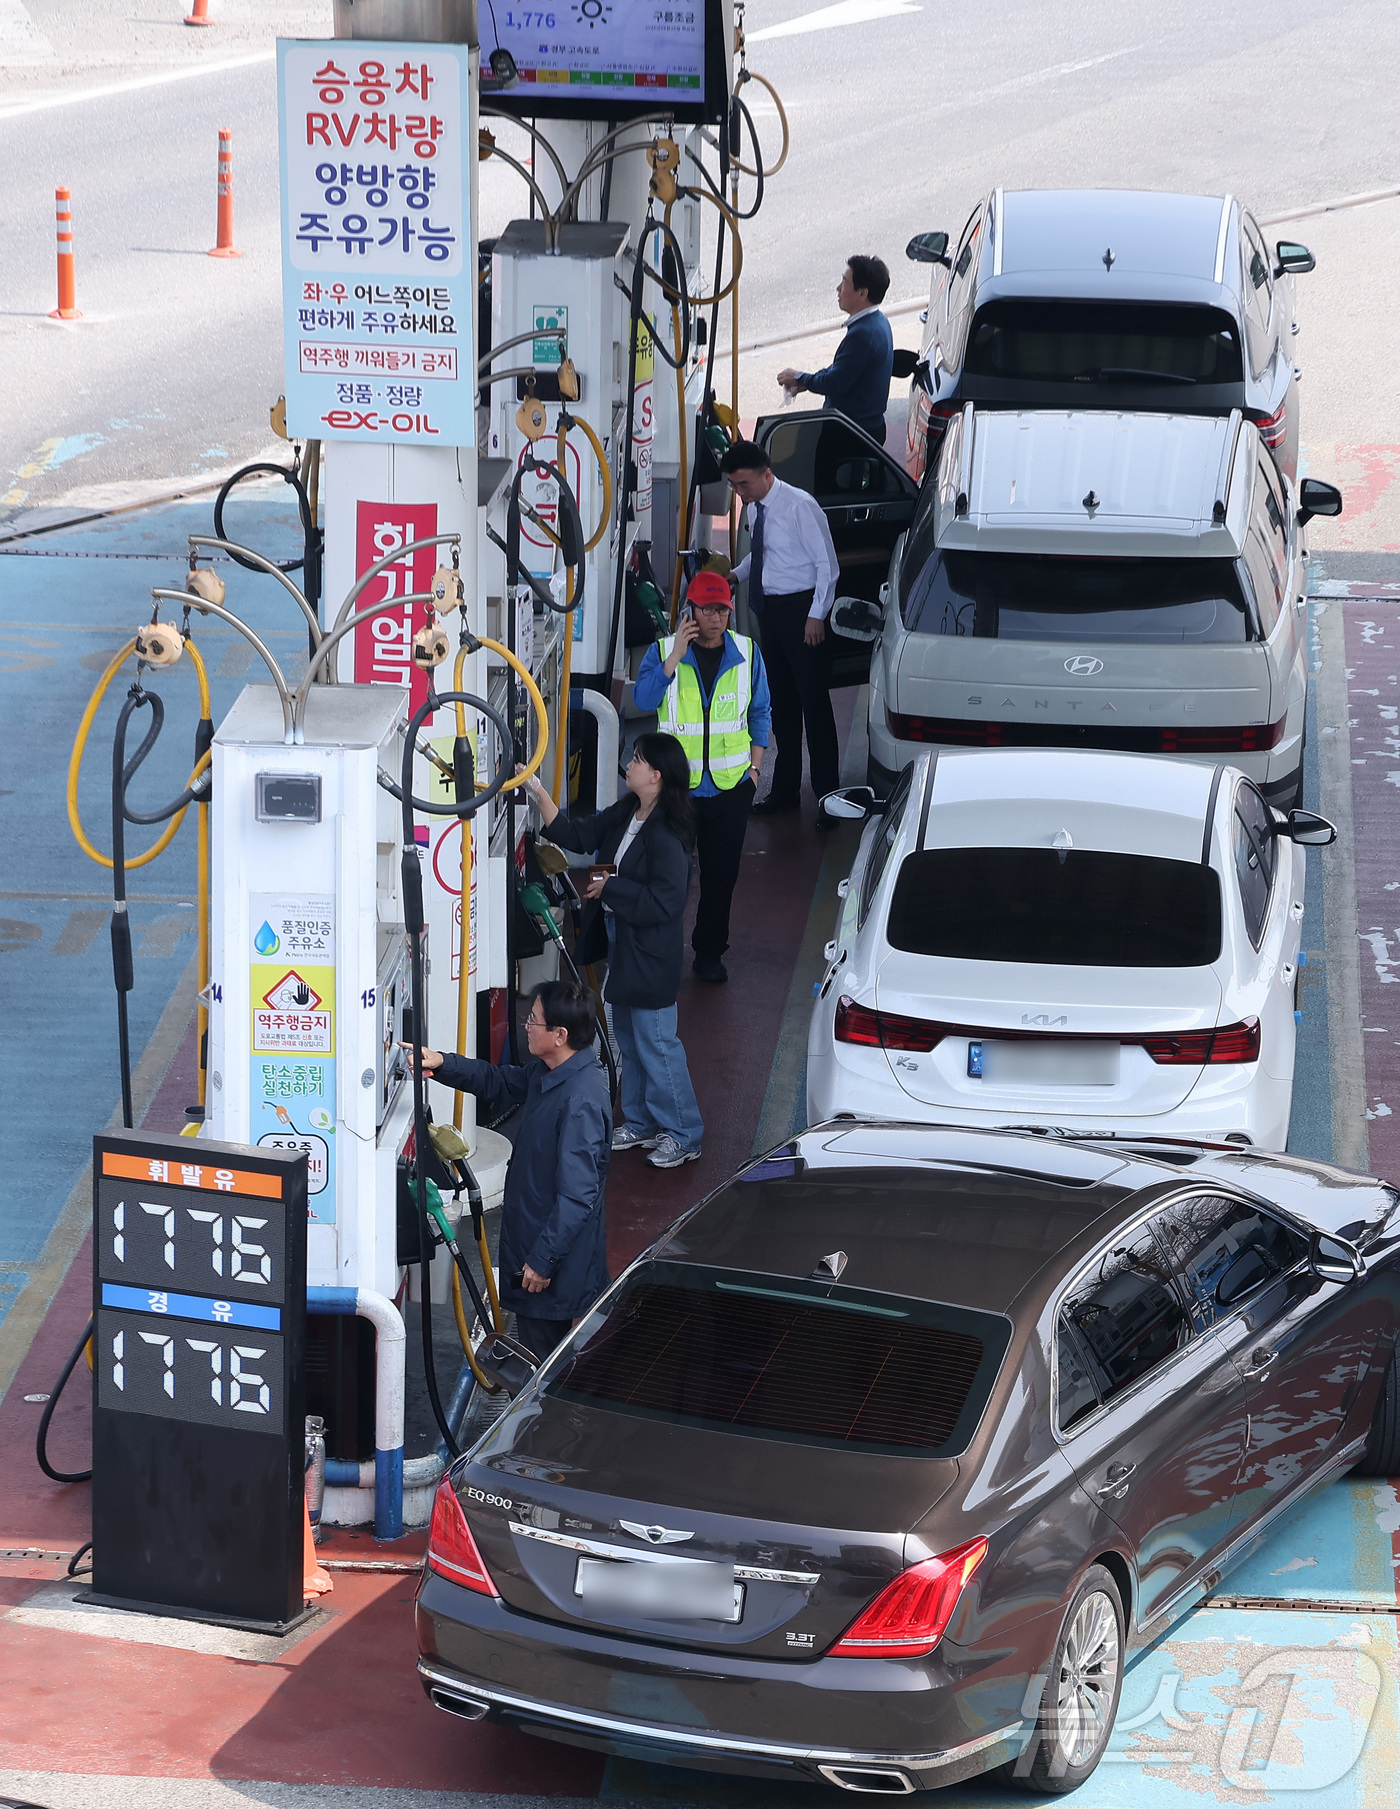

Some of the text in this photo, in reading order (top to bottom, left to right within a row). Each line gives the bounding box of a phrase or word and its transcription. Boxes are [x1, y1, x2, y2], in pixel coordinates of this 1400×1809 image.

[506, 11, 556, 31] 1,776
[312, 60, 434, 106] 승용차
[306, 112, 444, 159] RV차량
[315, 163, 436, 210] 양방향
[296, 213, 456, 261] 주유가능
[303, 282, 451, 311] 좌·우 어느쪽이든
[298, 308, 458, 335] 편하게 주유하세요
[303, 347, 452, 372] 역주행 끼워들기 금지
[492, 434, 498, 449] 6
[602, 437, 610, 452] 7
[967, 696, 1118, 713] SANTA
[281, 920, 332, 936] 품질인증
[287, 936, 326, 950] 주유소
[211, 982, 223, 1003] 14
[361, 988, 376, 1009] 15
[258, 1014, 327, 1031] 역주행금지
[262, 1064, 323, 1082] 탄소중립
[896, 1056, 919, 1073] K3
[262, 1080, 323, 1097] 실천하기
[113, 1200, 273, 1285] 1776
[112, 1330, 272, 1414] 1776
[467, 1486, 513, 1510] EQ900
[785, 1632, 817, 1642] 3.3T
